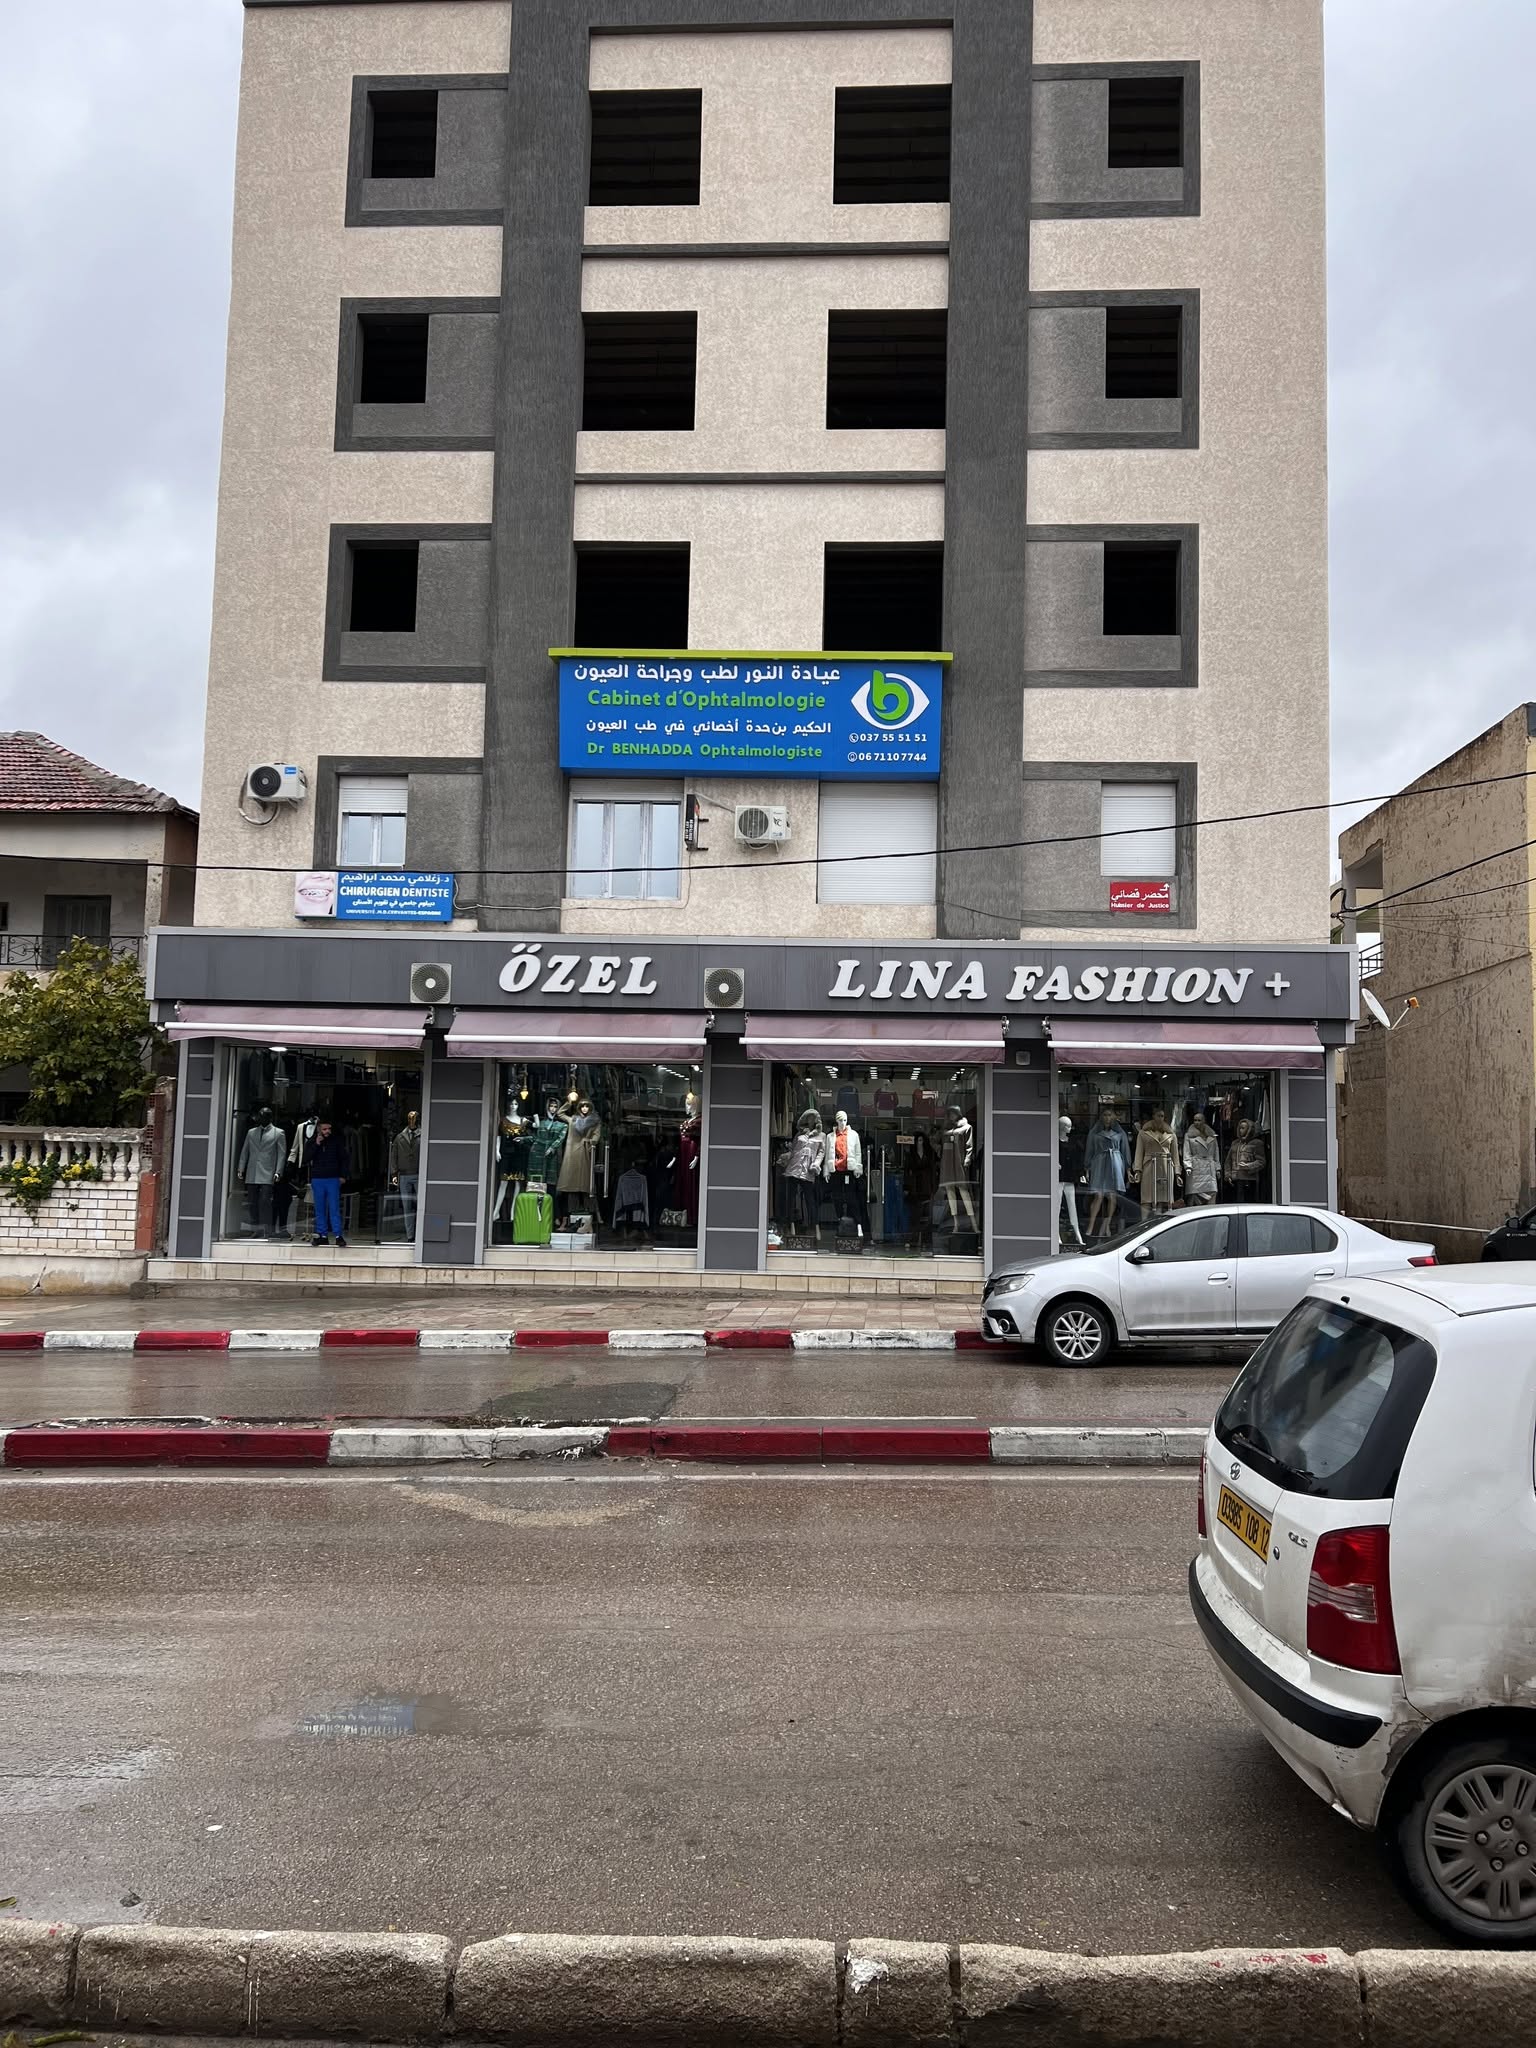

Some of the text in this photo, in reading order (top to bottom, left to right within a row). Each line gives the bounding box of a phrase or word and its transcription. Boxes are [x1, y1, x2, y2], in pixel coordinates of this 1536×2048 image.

[574, 664, 840, 685] عيادة النور لطب وجراحة العيون
[587, 689, 661, 706] Cabinet
[586, 719, 627, 733] العيون
[635, 719, 657, 734] طب
[664, 719, 685, 736] في
[693, 718, 738, 736] أخصائي
[792, 721, 831, 736] الحكيم
[859, 733, 927, 742] 037 55 51 51
[586, 742, 822, 759] Dr BENHADDA Ophtalmologiste
[380, 873, 406, 882] محمد
[340, 886, 450, 898] CHIRURGIEN DENTISTE
[1140, 890, 1169, 901] محضر
[499, 943, 657, 995] ÖZEL
[828, 959, 988, 1001] LINA
[1005, 965, 1254, 1004] FASHION
[1245, 1511, 1260, 1545] 108
[1260, 1525, 1271, 1555] 12
[1288, 1531, 1308, 1549] GLS
